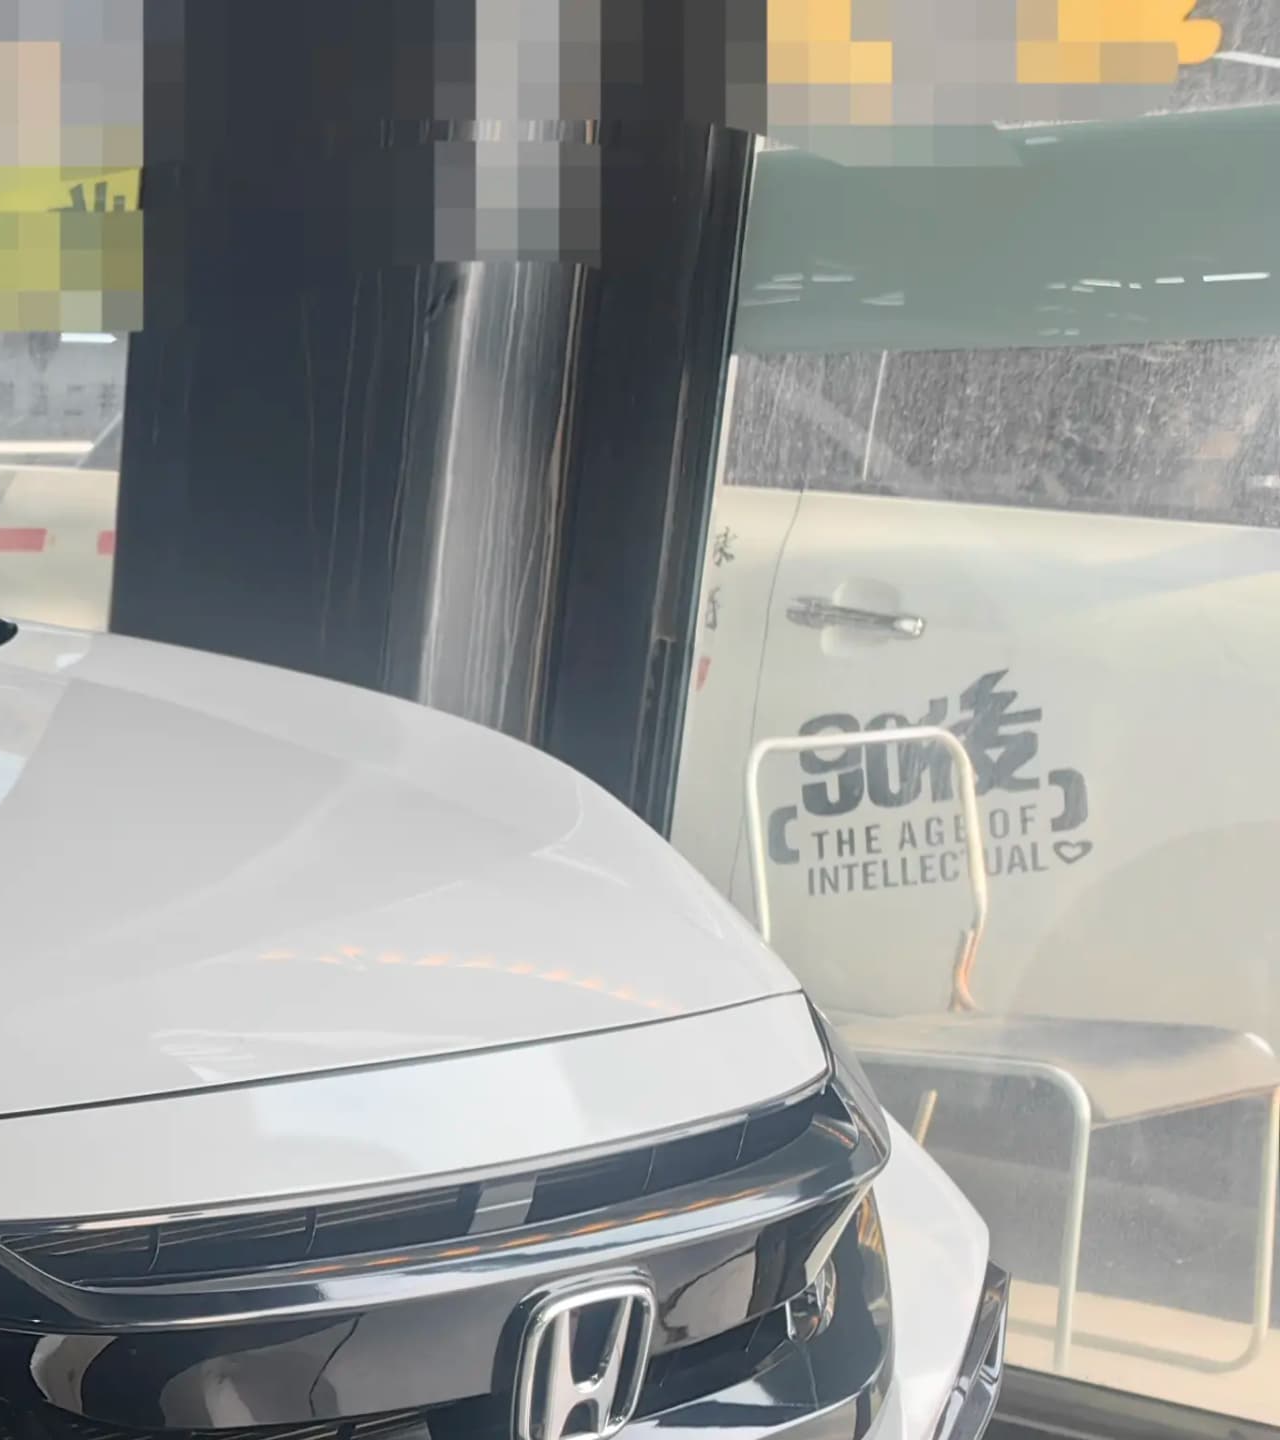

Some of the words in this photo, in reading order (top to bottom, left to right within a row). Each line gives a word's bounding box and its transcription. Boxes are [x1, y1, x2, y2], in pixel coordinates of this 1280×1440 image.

[812, 824, 881, 860] THE
[899, 814, 970, 852] AGE
[990, 804, 1037, 839] OF
[807, 841, 1049, 896] INTELLECUAL
